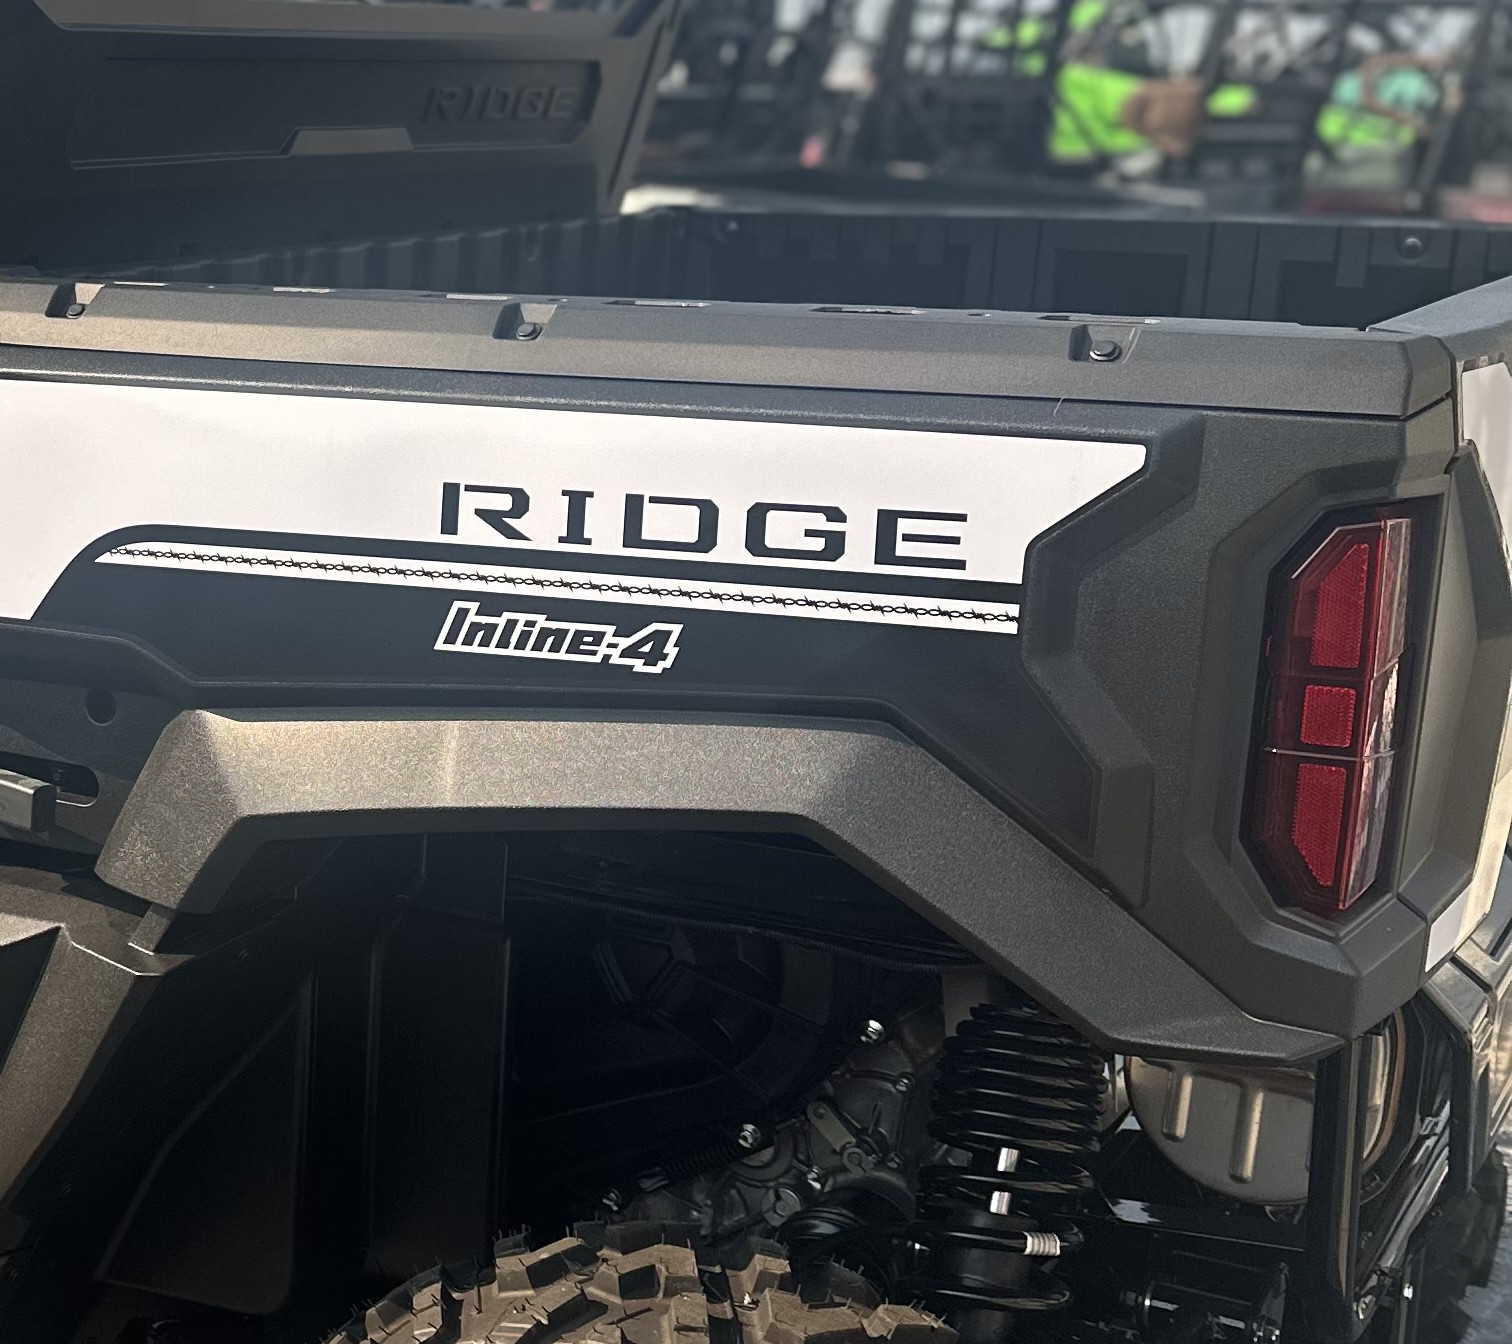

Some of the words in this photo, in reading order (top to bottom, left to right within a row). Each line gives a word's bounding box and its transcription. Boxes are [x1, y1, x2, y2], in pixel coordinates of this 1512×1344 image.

[424, 85, 579, 122] RIDGE
[440, 482, 969, 571] RIDGE
[434, 600, 684, 674] Inline-4
